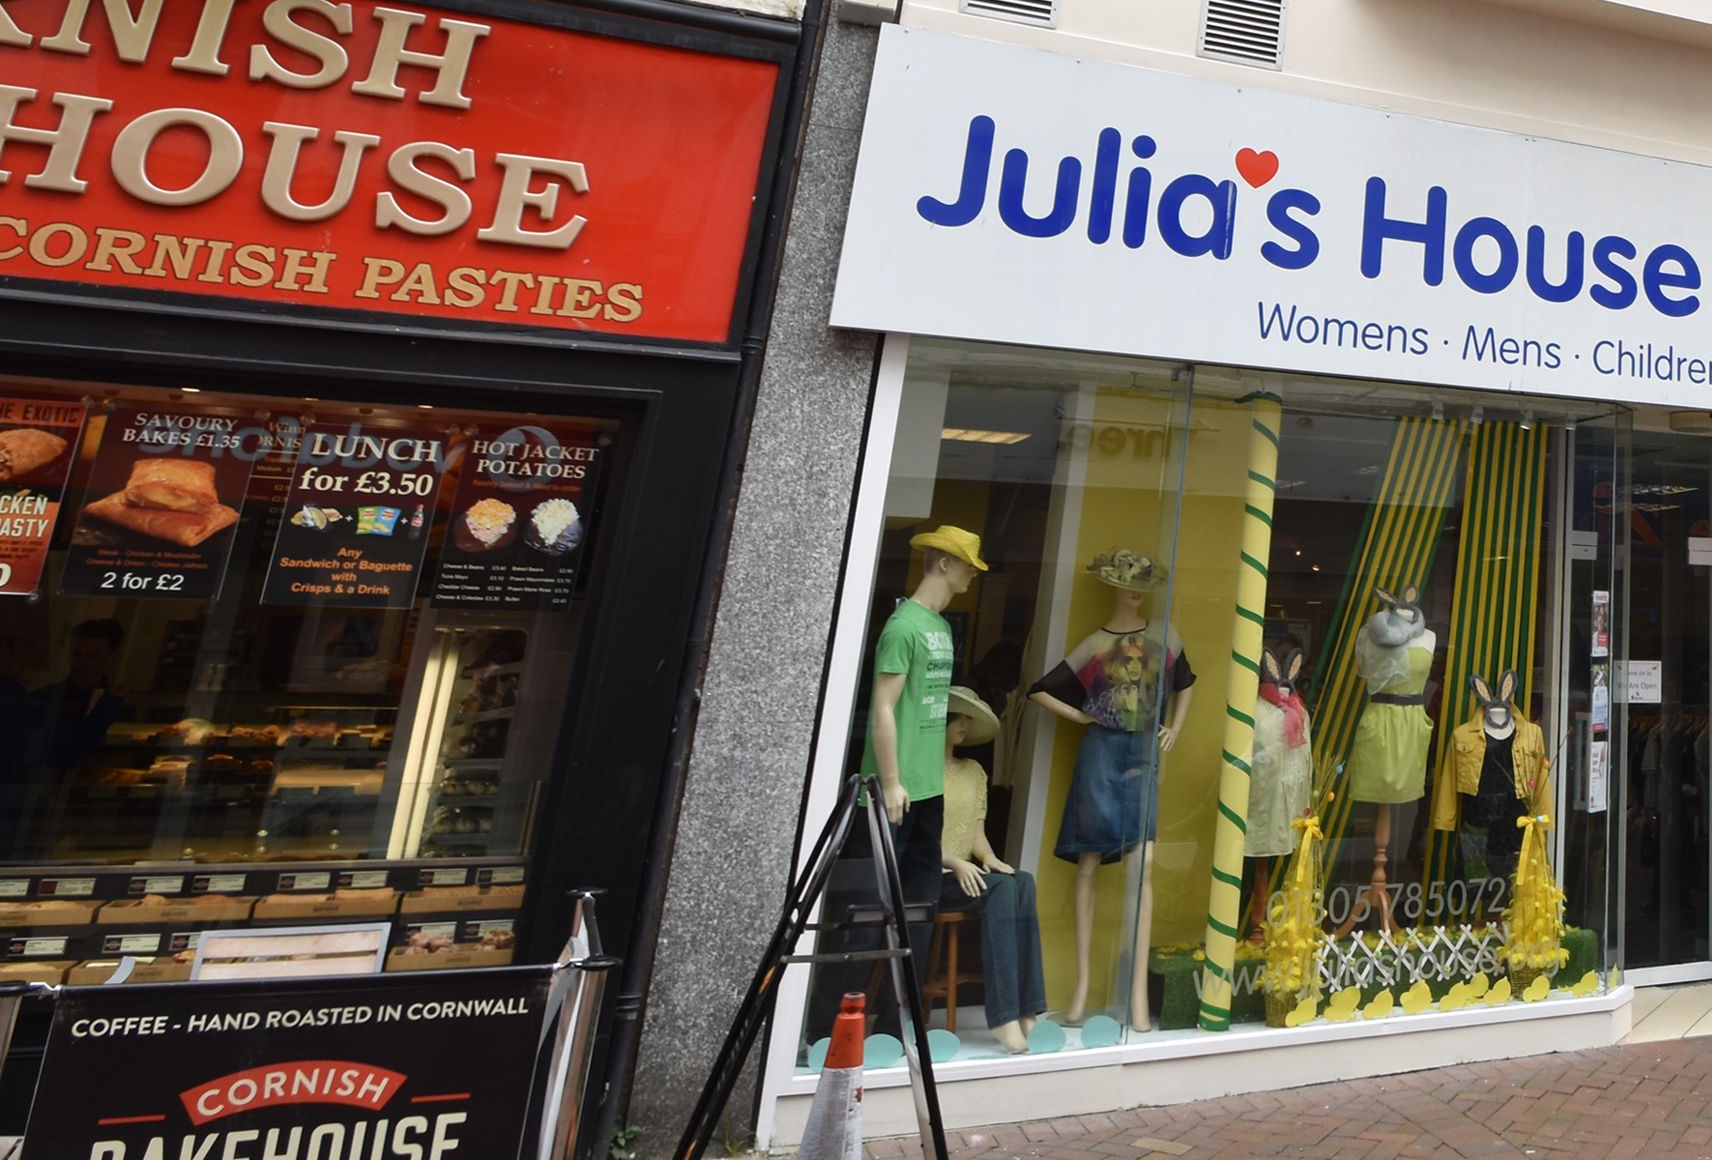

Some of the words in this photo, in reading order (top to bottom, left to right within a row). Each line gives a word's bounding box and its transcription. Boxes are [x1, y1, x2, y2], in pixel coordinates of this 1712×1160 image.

[1360, 175, 1702, 318] House
[355, 256, 644, 324] PASTIES
[1257, 301, 1429, 357] Womens
[1461, 325, 1561, 371] Mens
[22, 405, 81, 424] EXOTIC
[134, 412, 238, 432] SAVOURY
[122, 428, 191, 446] BAKES
[195, 433, 241, 448] £1.35
[311, 432, 440, 463] LUNCH
[472, 440, 519, 456] HOT
[520, 443, 600, 462] JACKET
[476, 458, 587, 479] POTATOES
[299, 466, 349, 492] for
[354, 470, 434, 496] £3.50
[0, 518, 49, 537] ASTY
[337, 547, 363, 559] Any
[280, 557, 340, 569] Sandwich
[343, 560, 356, 569] or
[359, 560, 413, 573] Baguette
[100, 571, 117, 589] 2
[121, 572, 152, 590] for
[155, 573, 185, 591] £2
[331, 572, 357, 582] with
[291, 583, 331, 594] Crisps
[334, 584, 344, 594] &
[357, 584, 391, 595] Drink
[1387, 877, 1506, 920] 785072
[71, 1016, 166, 1037] COFFEE
[187, 1012, 260, 1033] HAND
[265, 1006, 373, 1029] ROASTED
[377, 1005, 402, 1022] IN
[406, 997, 529, 1022] CORNWALL
[196, 1068, 390, 1116] CORNISH
